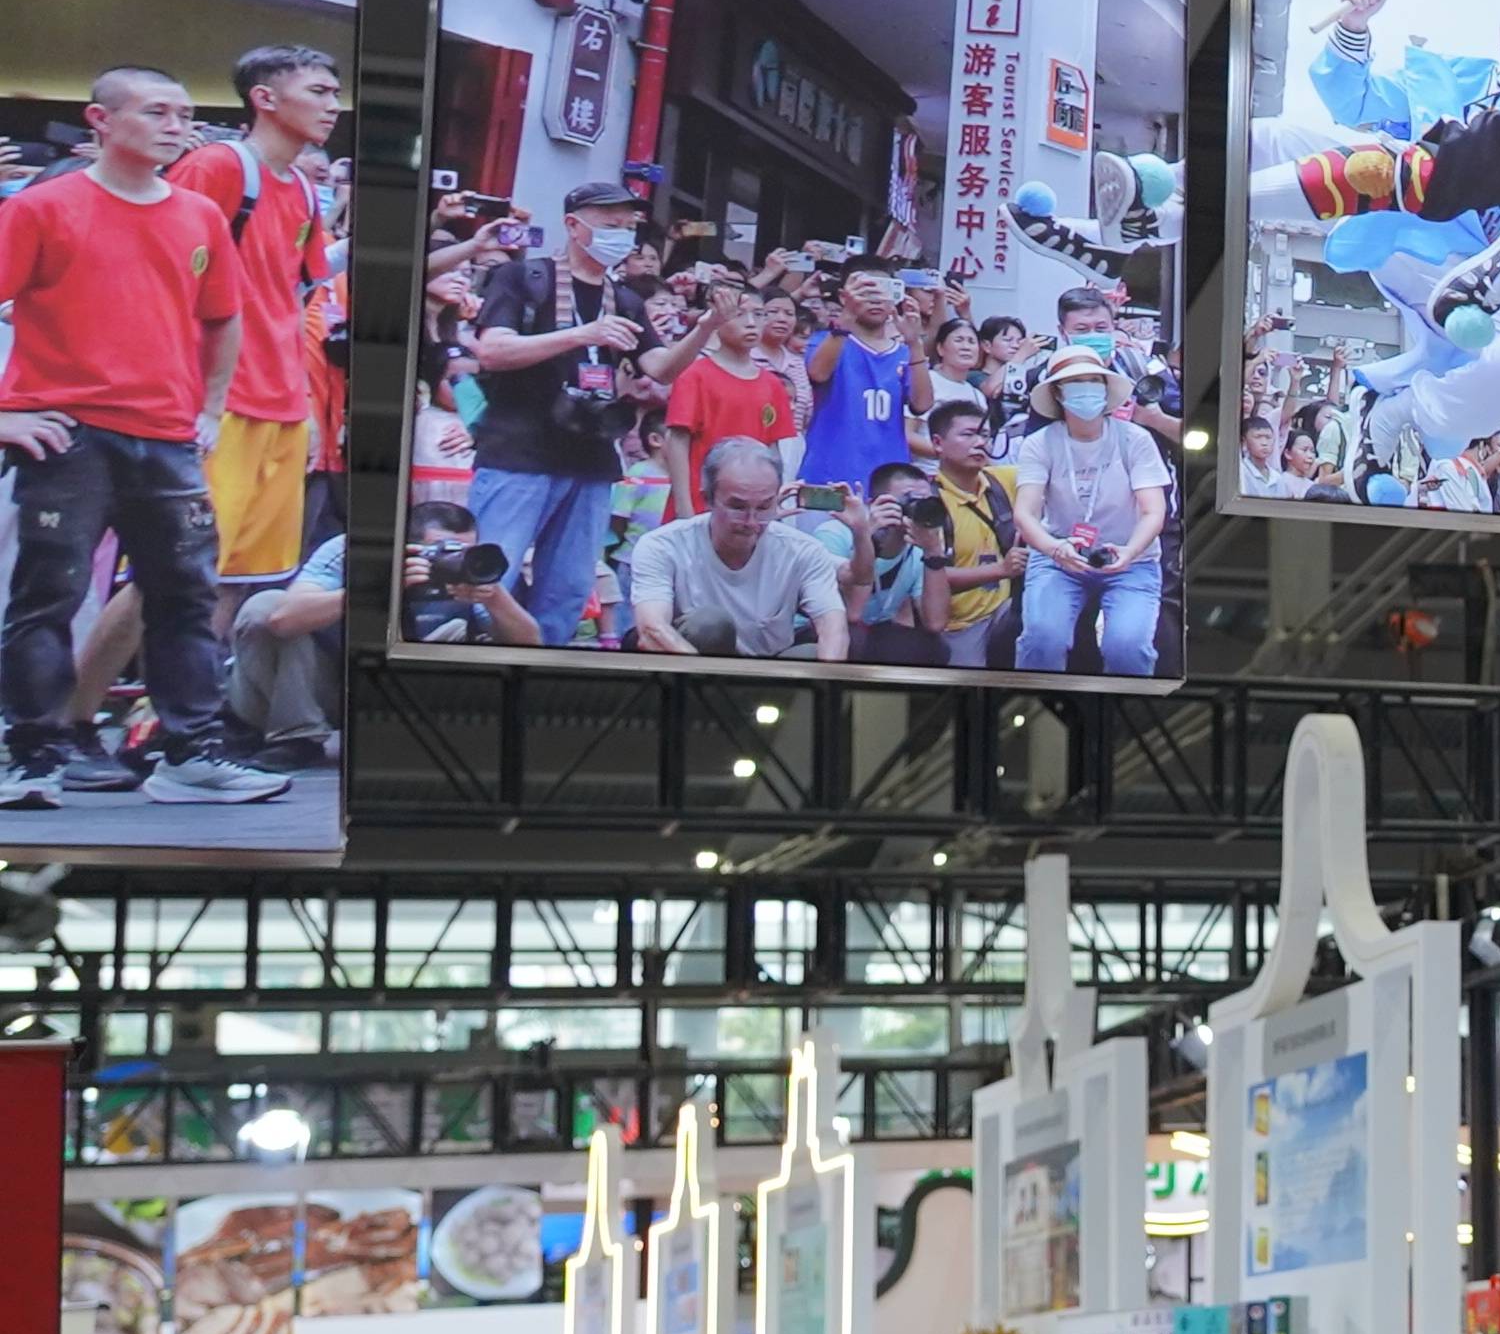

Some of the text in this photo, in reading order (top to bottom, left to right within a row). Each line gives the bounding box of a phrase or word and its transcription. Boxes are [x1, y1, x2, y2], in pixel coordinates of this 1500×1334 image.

[949, 42, 996, 280] 游客服务中心
[993, 50, 1021, 274] Tourist Service enter
[863, 388, 891, 421] 10
